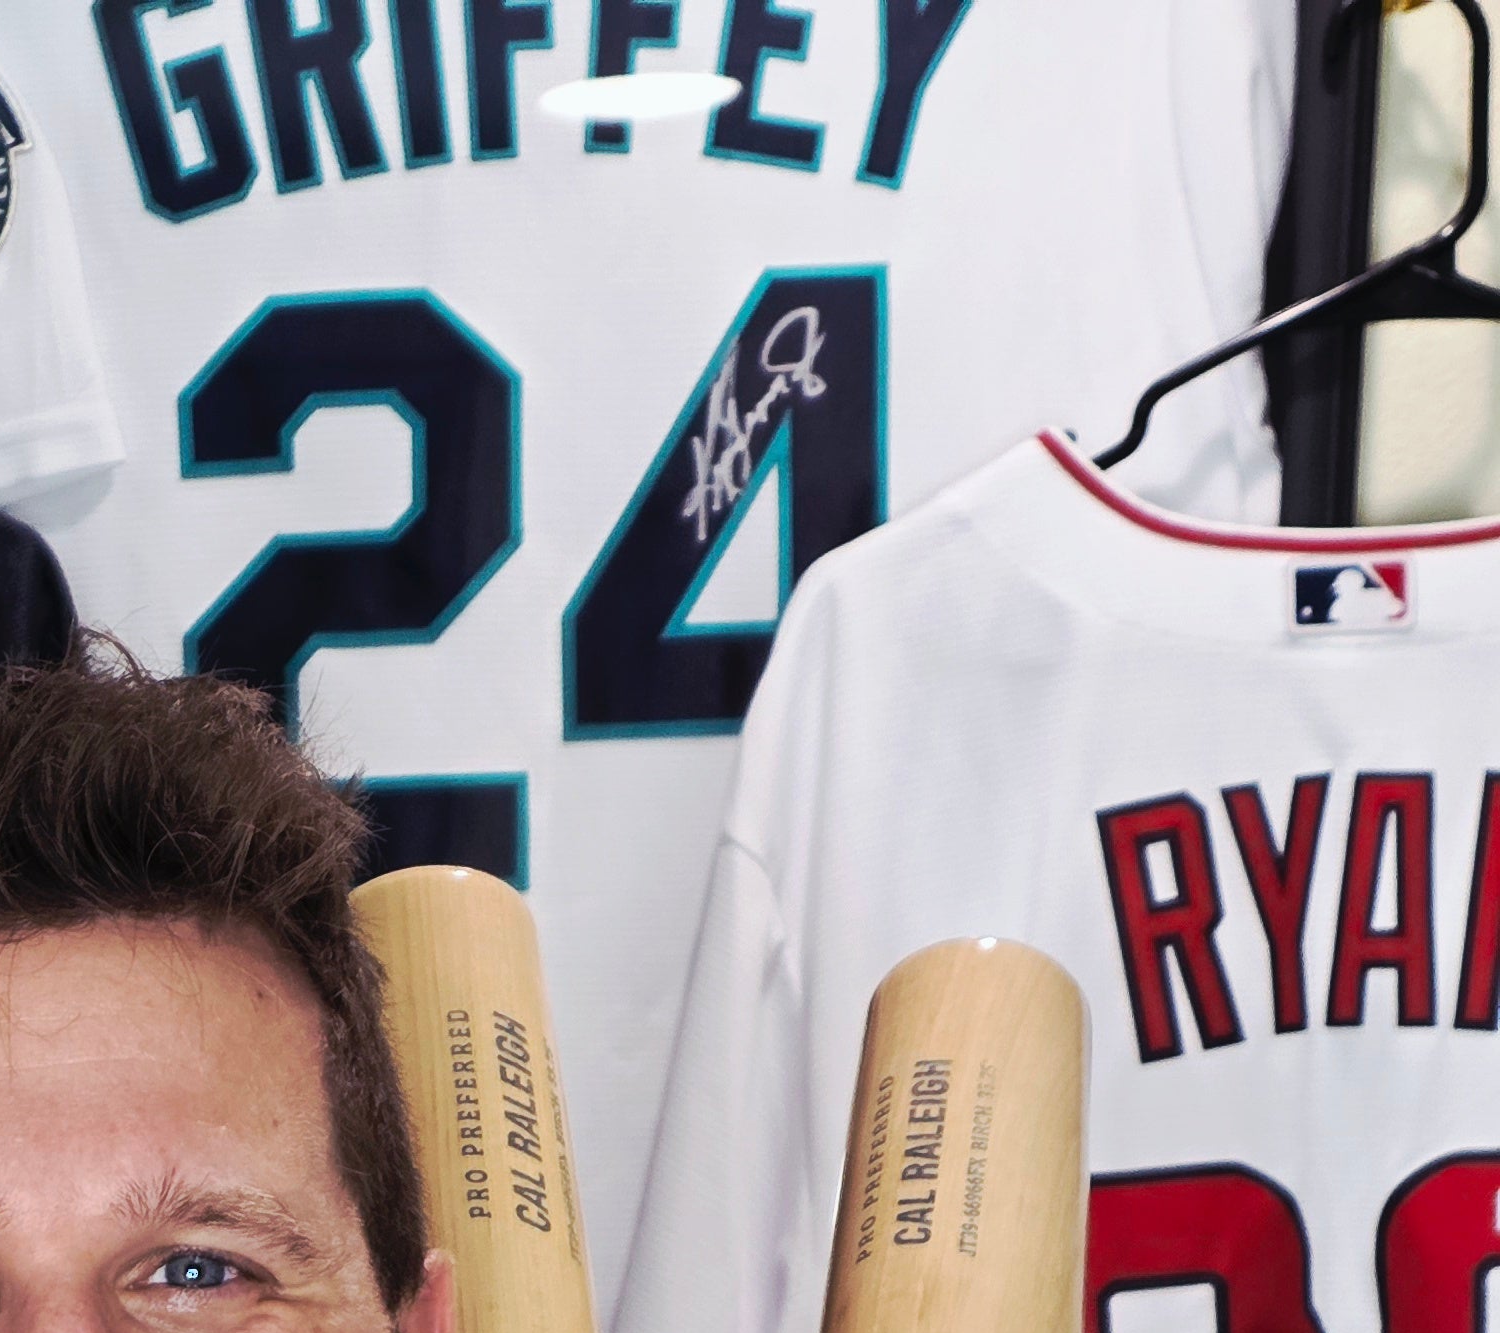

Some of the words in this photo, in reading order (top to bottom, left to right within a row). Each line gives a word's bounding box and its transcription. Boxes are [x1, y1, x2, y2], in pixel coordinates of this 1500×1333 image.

[90, 0, 975, 223] GRIFFEY
[176, 262, 890, 890] 24
[446, 1009, 484, 1157] PREFERRED
[493, 1010, 541, 1163] RALEIGH
[861, 1075, 896, 1210] PREFERRED
[899, 1058, 954, 1182] RALEIGH
[969, 1104, 994, 1152] BIRCH
[465, 1169, 492, 1219] PRO
[510, 1168, 552, 1233] CAL
[855, 1215, 878, 1265] PRO
[893, 1189, 937, 1247] CAL
